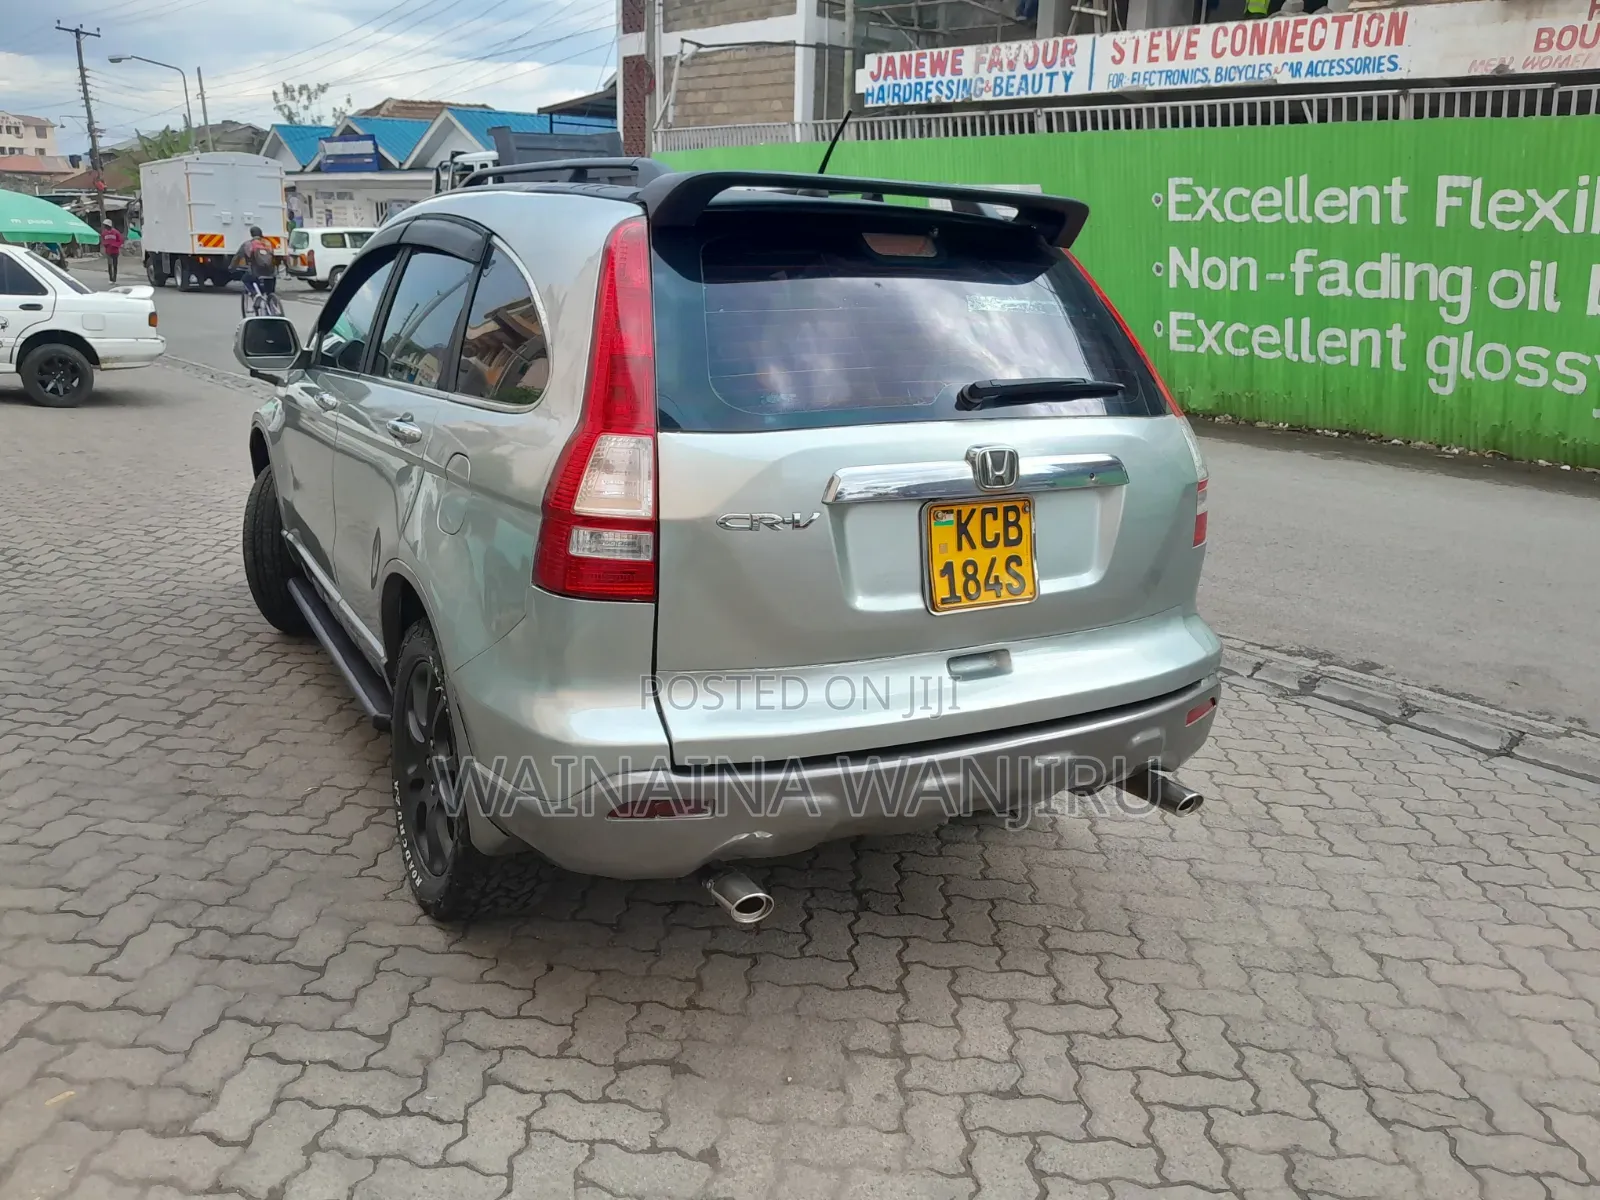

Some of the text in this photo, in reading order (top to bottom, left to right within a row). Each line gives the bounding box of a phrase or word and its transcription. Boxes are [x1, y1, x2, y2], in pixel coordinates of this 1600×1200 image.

[869, 38, 1078, 82] JANEWE FAVOUR
[1110, 11, 1409, 65] STEVE CONNECTION
[1168, 173, 1408, 225] Excellent
[1488, 259, 1561, 314] oil
[1168, 311, 1600, 418] Excellent gloss
[716, 512, 821, 532] CR-V
[956, 504, 1023, 552] KCB
[939, 554, 1026, 605] 184S
